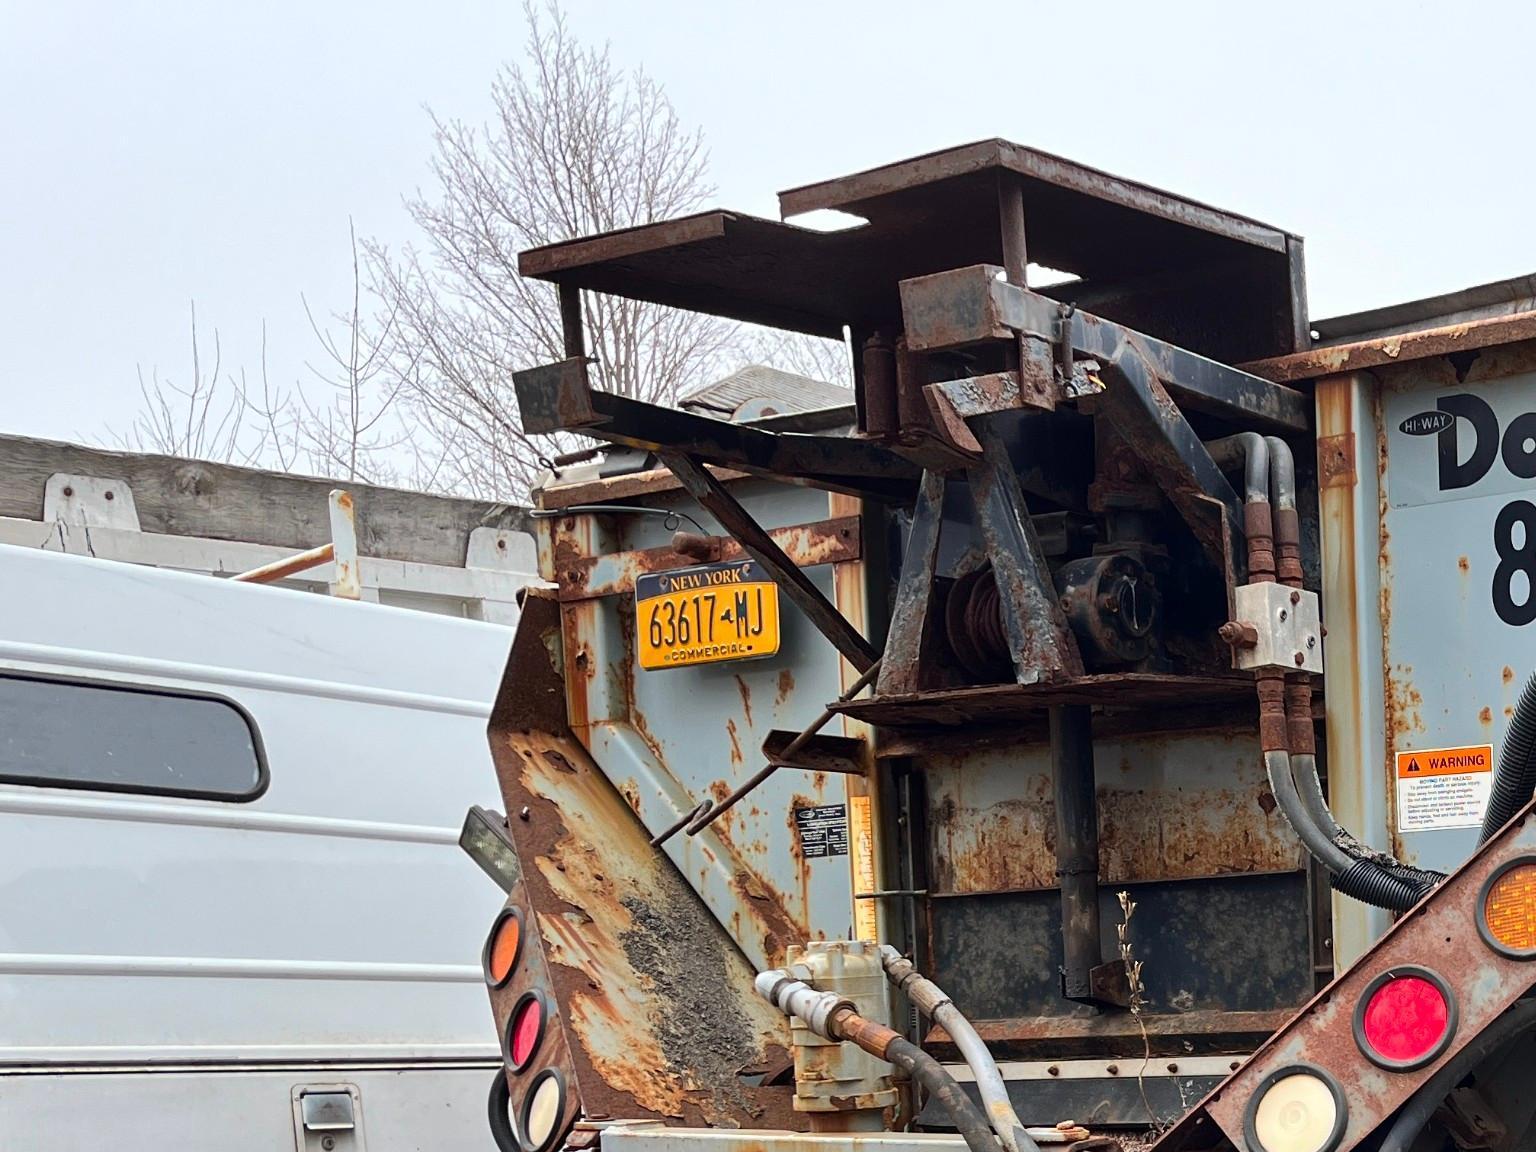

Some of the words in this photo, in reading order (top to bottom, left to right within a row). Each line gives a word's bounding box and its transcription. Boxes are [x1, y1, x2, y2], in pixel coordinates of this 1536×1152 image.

[1404, 414, 1447, 433] HI-WAY
[669, 573, 704, 592] NEW
[705, 567, 742, 585] YORK
[649, 591, 717, 649] 63617
[671, 643, 747, 661] COMMERCIAL
[1429, 755, 1485, 769] WARNING
